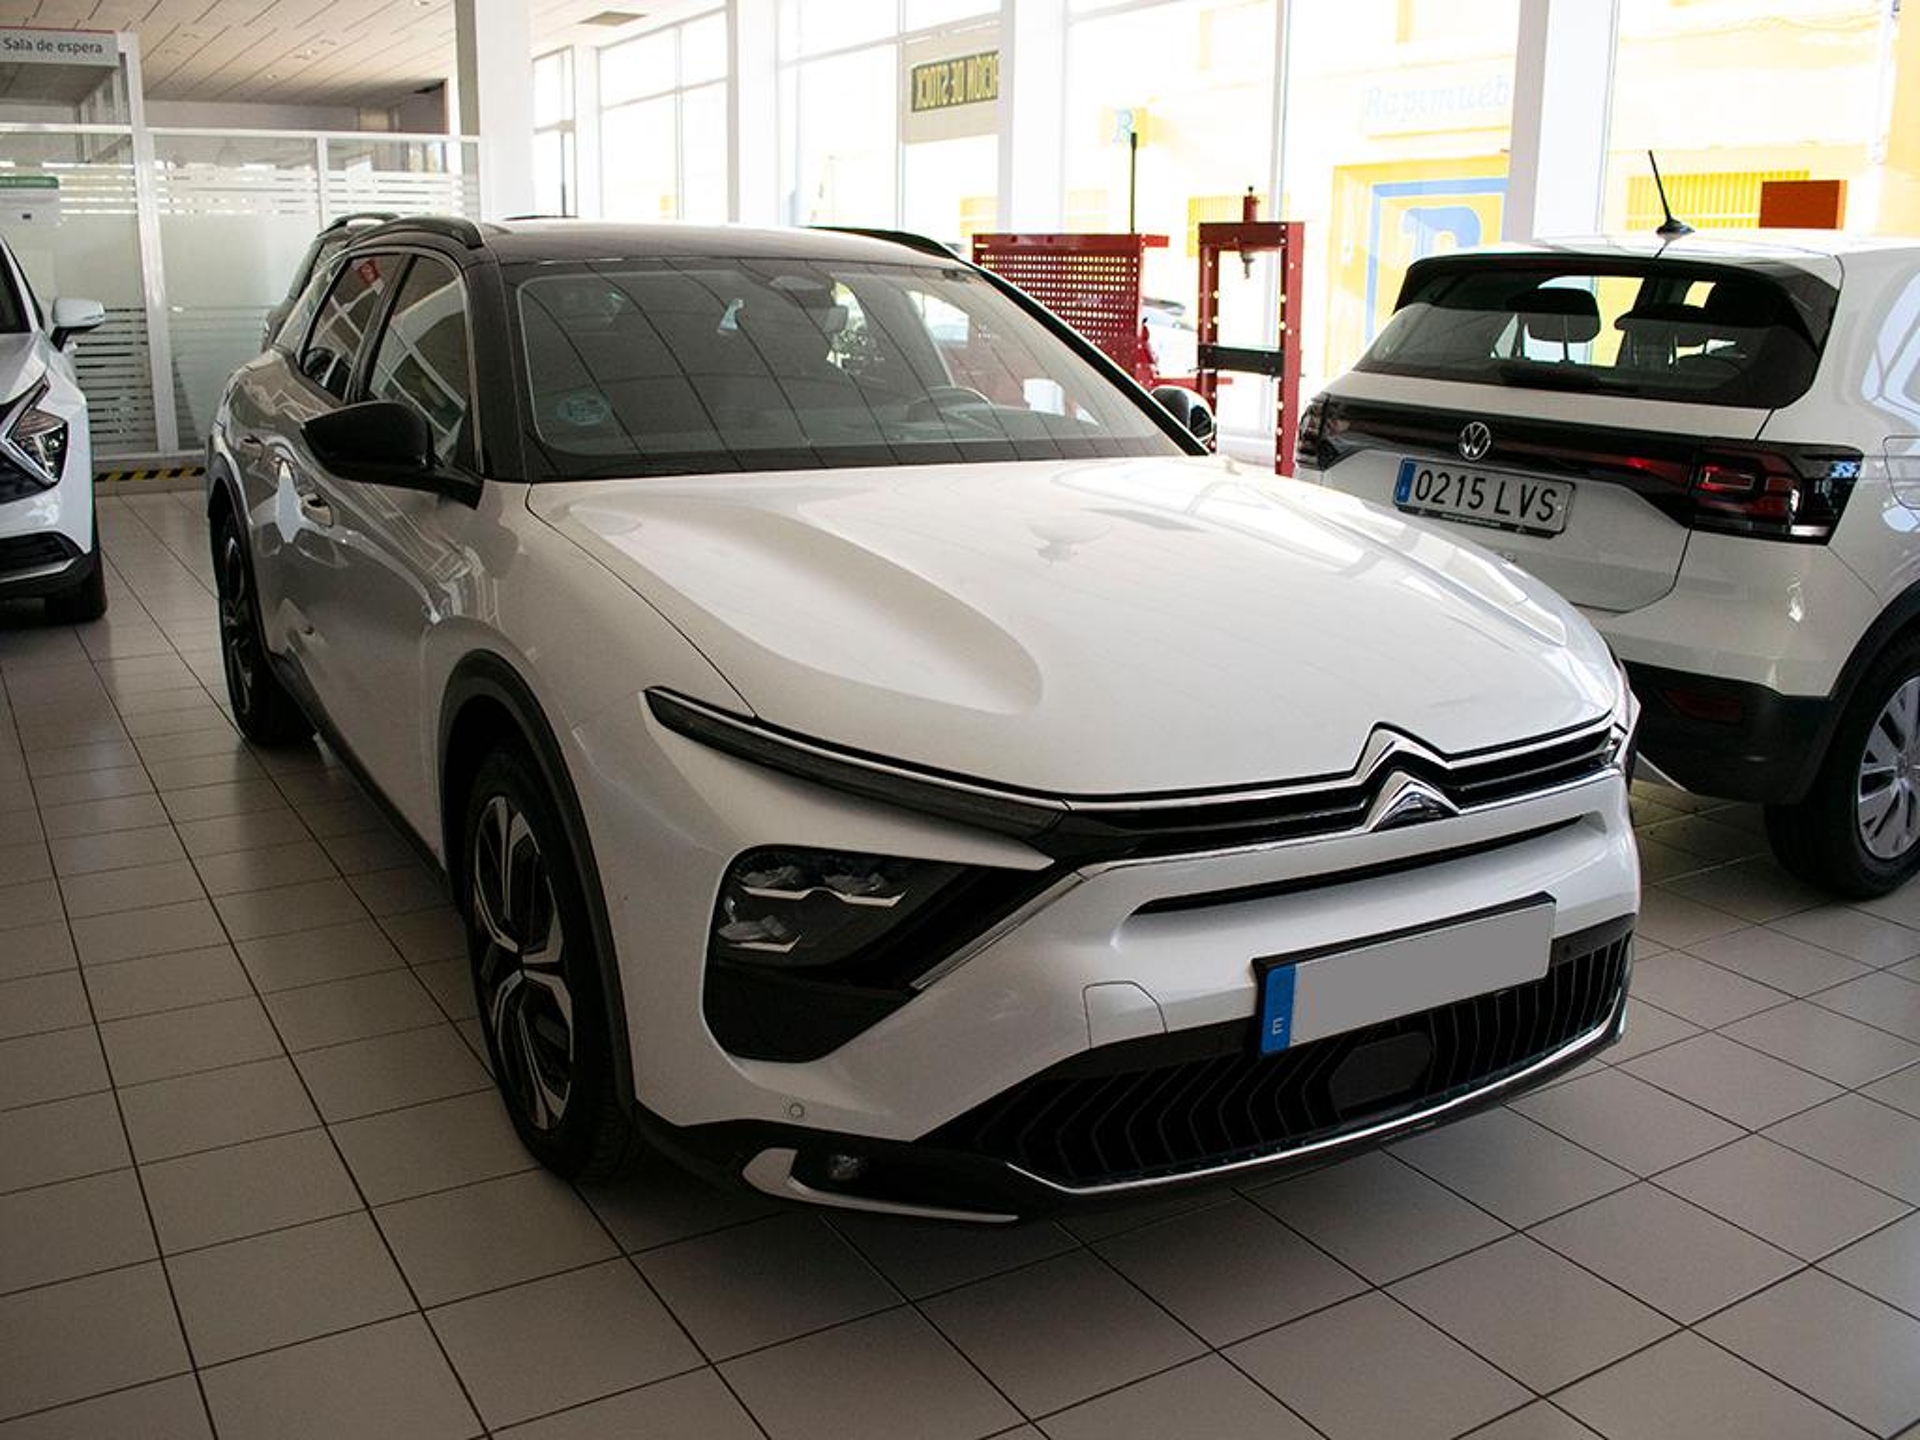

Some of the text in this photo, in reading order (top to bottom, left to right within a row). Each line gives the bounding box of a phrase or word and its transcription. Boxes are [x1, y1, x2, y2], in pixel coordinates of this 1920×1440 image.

[3, 37, 103, 56] Sala de espera
[1415, 470, 1485, 510] 0215
[1494, 481, 1558, 522] LVS
[1271, 1017, 1285, 1036] E
